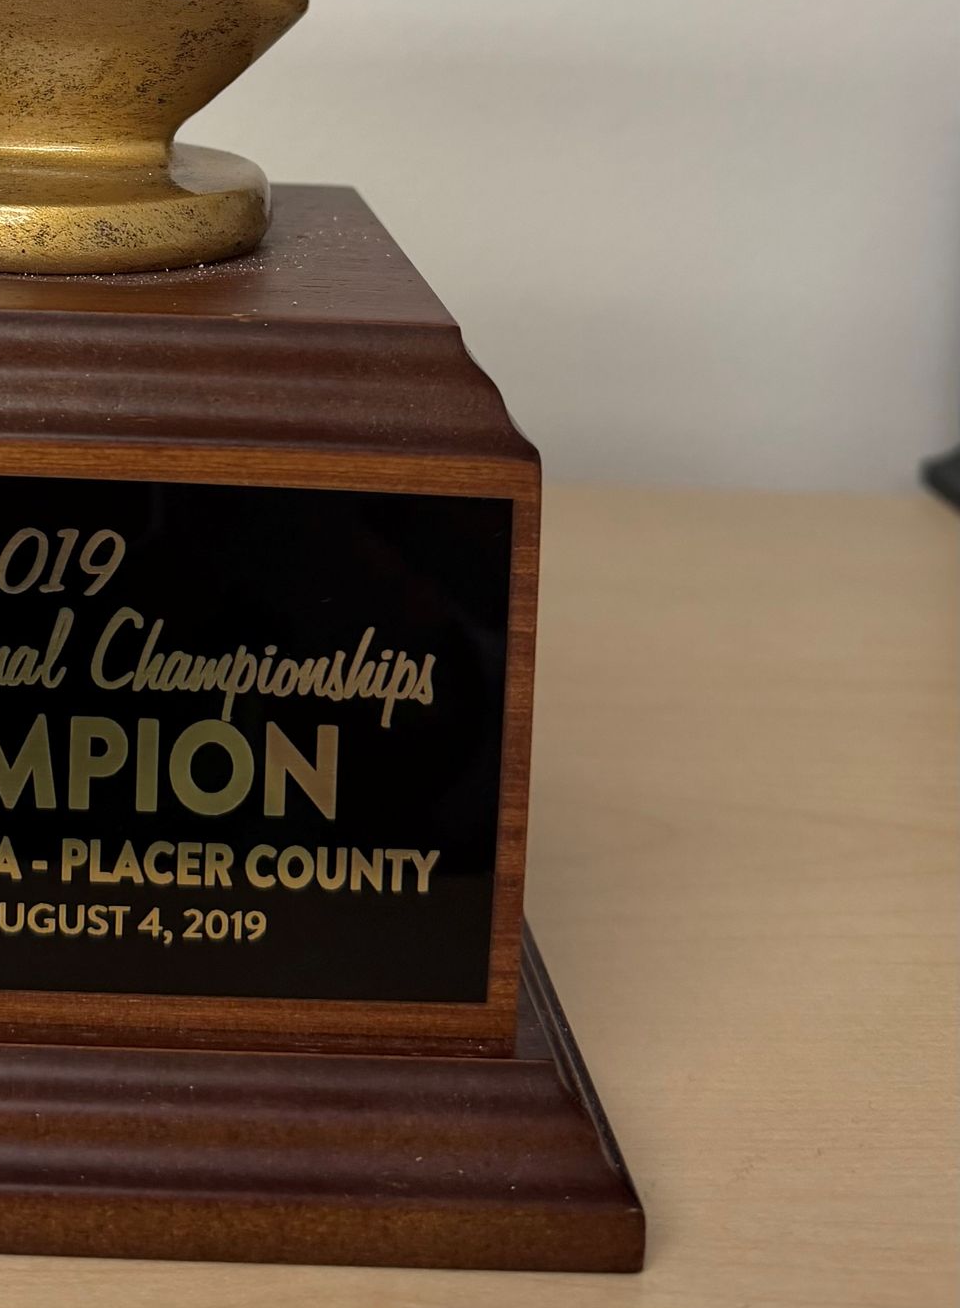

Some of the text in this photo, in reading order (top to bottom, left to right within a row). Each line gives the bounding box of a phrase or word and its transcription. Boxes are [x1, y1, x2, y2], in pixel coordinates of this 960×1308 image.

[91, 607, 436, 728] Championships
[61, 838, 235, 888] PLACER
[245, 843, 440, 894] COUNTY
[137, 907, 173, 946] 4,
[182, 908, 267, 942] 2019
